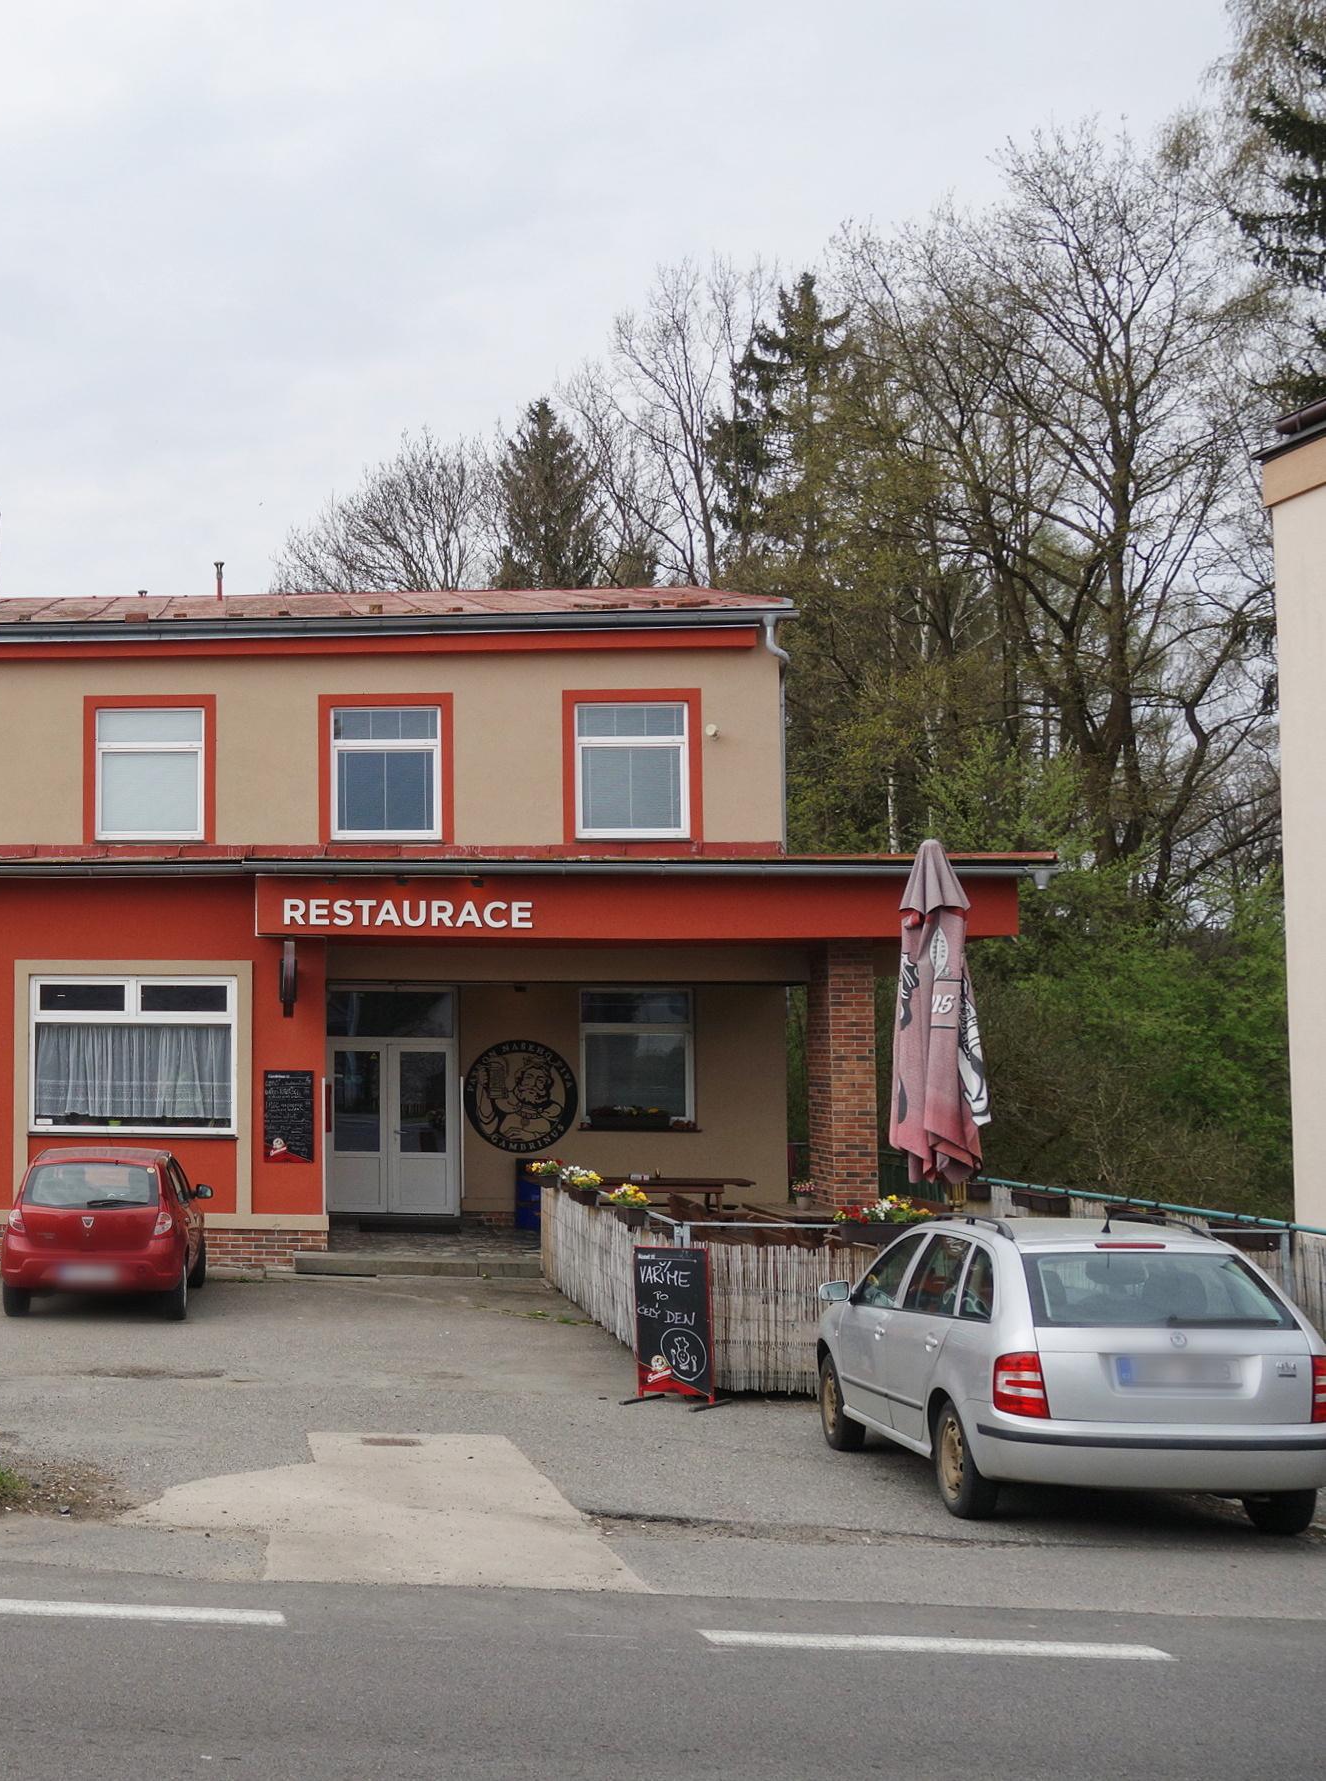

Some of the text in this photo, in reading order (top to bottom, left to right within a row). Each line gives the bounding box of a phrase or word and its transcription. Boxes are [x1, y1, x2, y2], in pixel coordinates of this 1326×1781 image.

[283, 898, 533, 929] RESTAURACE
[491, 1123, 565, 1151] GAMBRINUS
[639, 1260, 692, 1288] VAŘÍME
[664, 1310, 695, 1326] DEN
